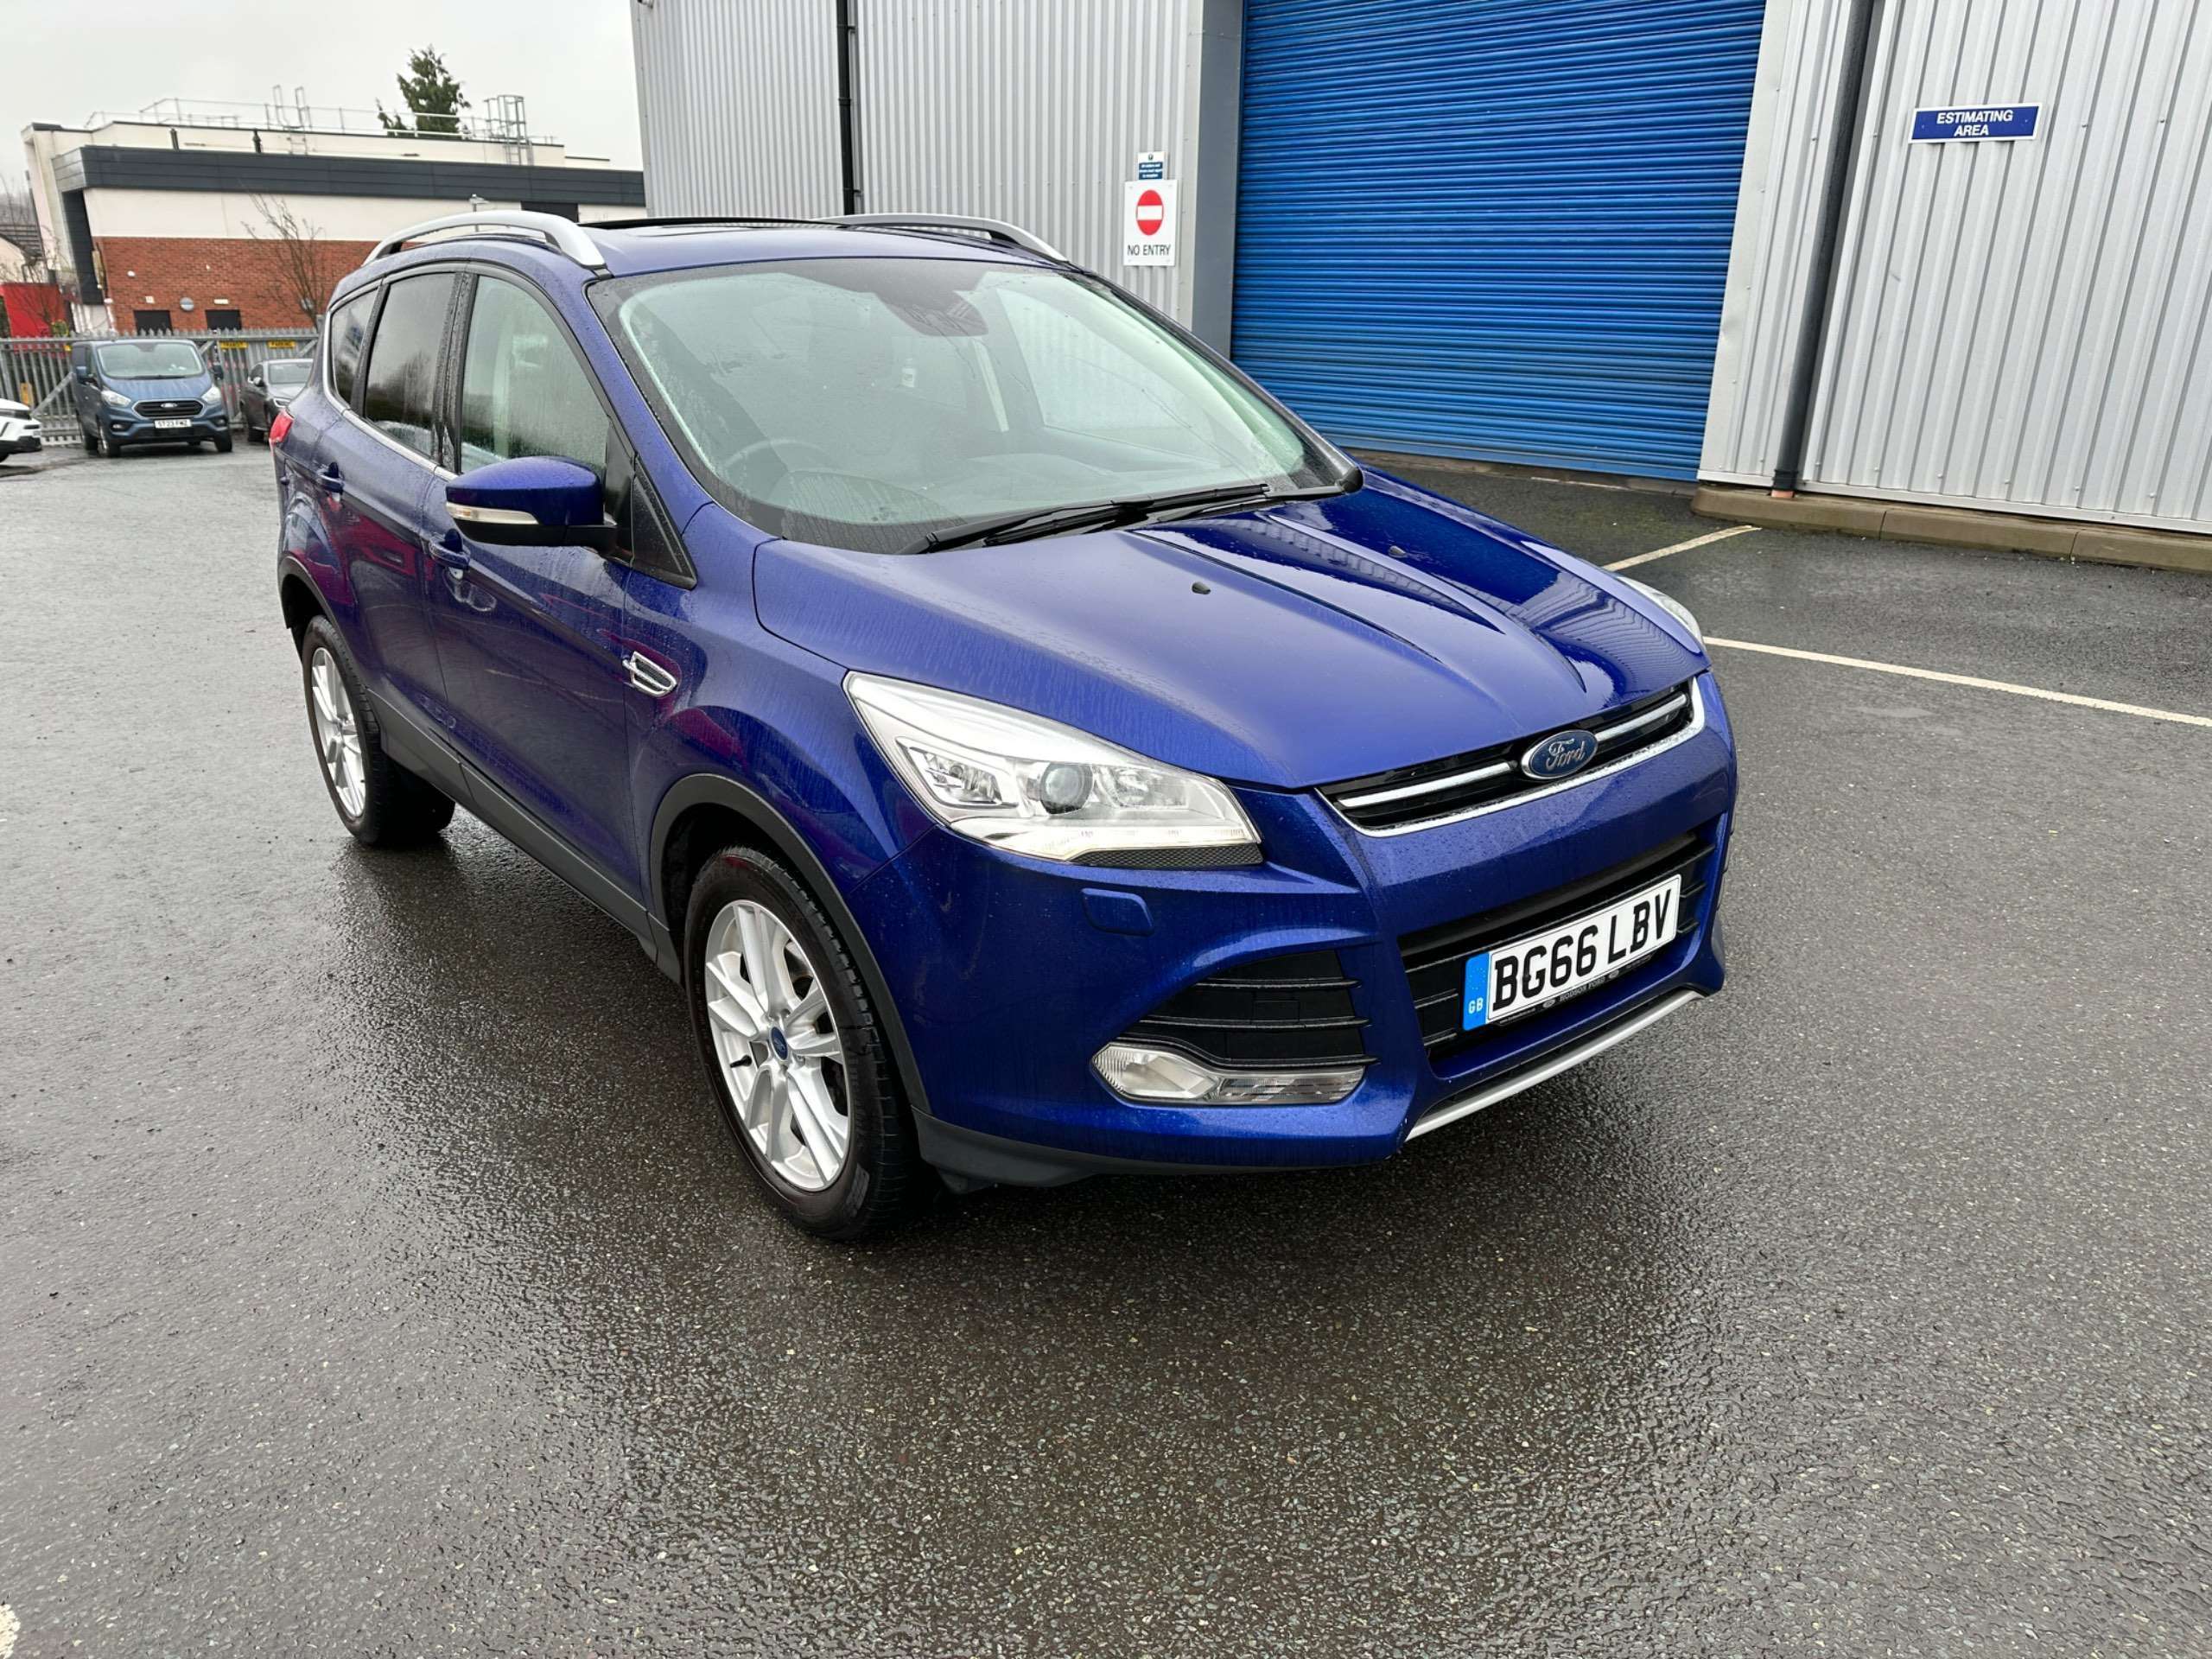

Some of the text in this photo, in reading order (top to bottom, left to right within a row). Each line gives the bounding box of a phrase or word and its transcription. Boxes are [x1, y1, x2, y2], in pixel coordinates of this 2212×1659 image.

[1936, 110, 2013, 124] ESTIMATING
[1954, 124, 1989, 137] AREA
[1128, 244, 1171, 256] NO ENTRY
[1545, 737, 1586, 772] Ford
[1492, 889, 1671, 1012] BG66 LBV
[1468, 997, 1484, 1014] GB
